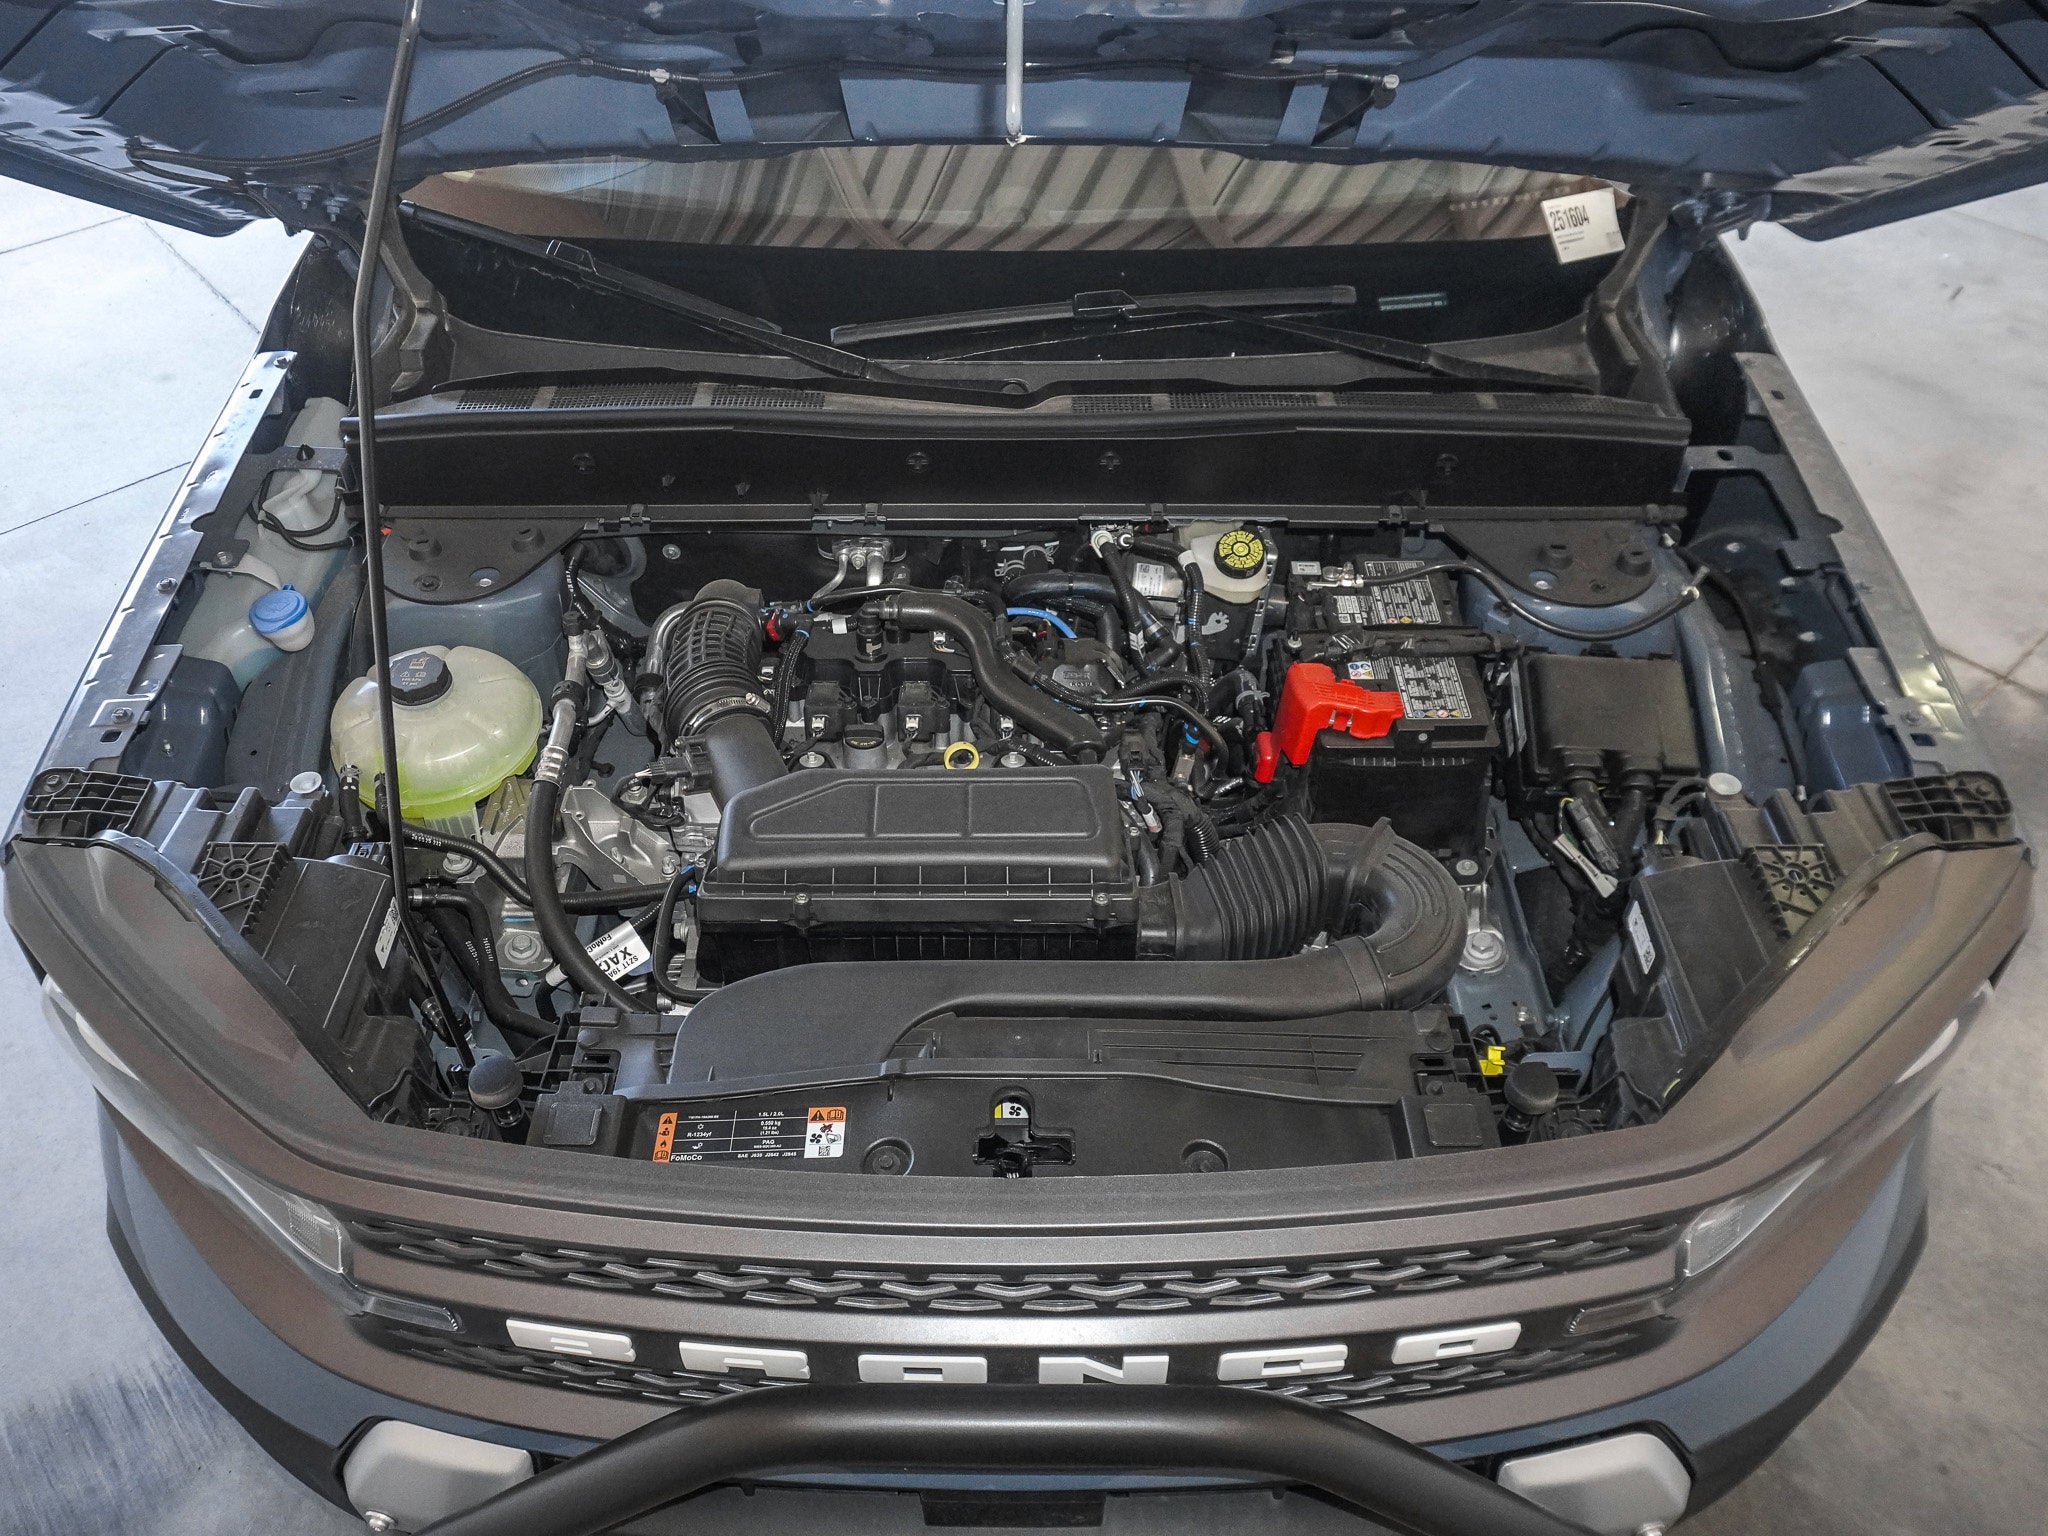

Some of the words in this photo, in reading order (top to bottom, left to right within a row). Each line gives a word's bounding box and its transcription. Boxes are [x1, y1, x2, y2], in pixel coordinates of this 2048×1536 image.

[1549, 205, 1590, 231] 251604
[670, 1154, 703, 1162] FoMoCo
[506, 1318, 1522, 1385] BRONCO
